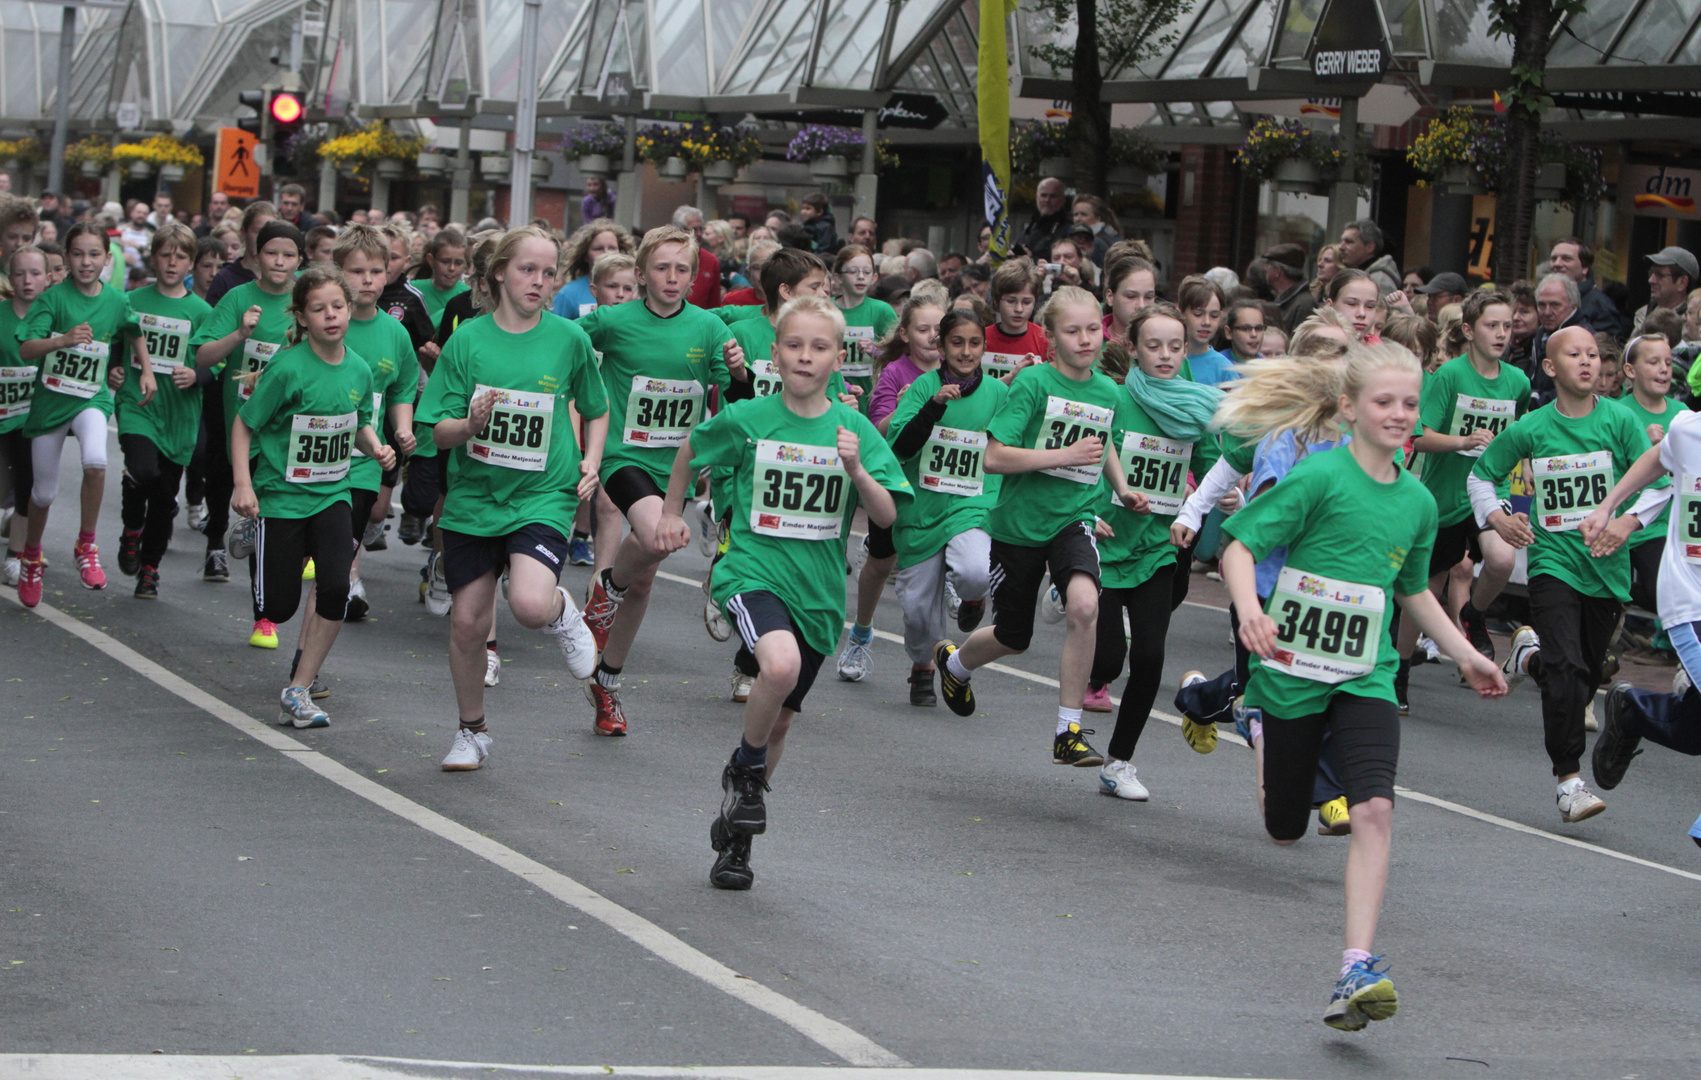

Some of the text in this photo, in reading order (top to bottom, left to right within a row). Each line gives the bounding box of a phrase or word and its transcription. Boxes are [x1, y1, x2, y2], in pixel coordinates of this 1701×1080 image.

[1315, 49, 1381, 75] GERRY WEBER
[1646, 165, 1691, 197] dm
[143, 330, 180, 358] 519
[52, 350, 100, 382] 3521
[0, 382, 35, 404] 352
[637, 397, 693, 427] 3412
[296, 432, 351, 463] 3506
[929, 445, 980, 478] 3491
[1127, 455, 1183, 494] 3514
[763, 469, 843, 513] 3520
[1542, 473, 1607, 510] 3526
[1277, 599, 1369, 658] 3499
[1295, 658, 1321, 669] Emder
